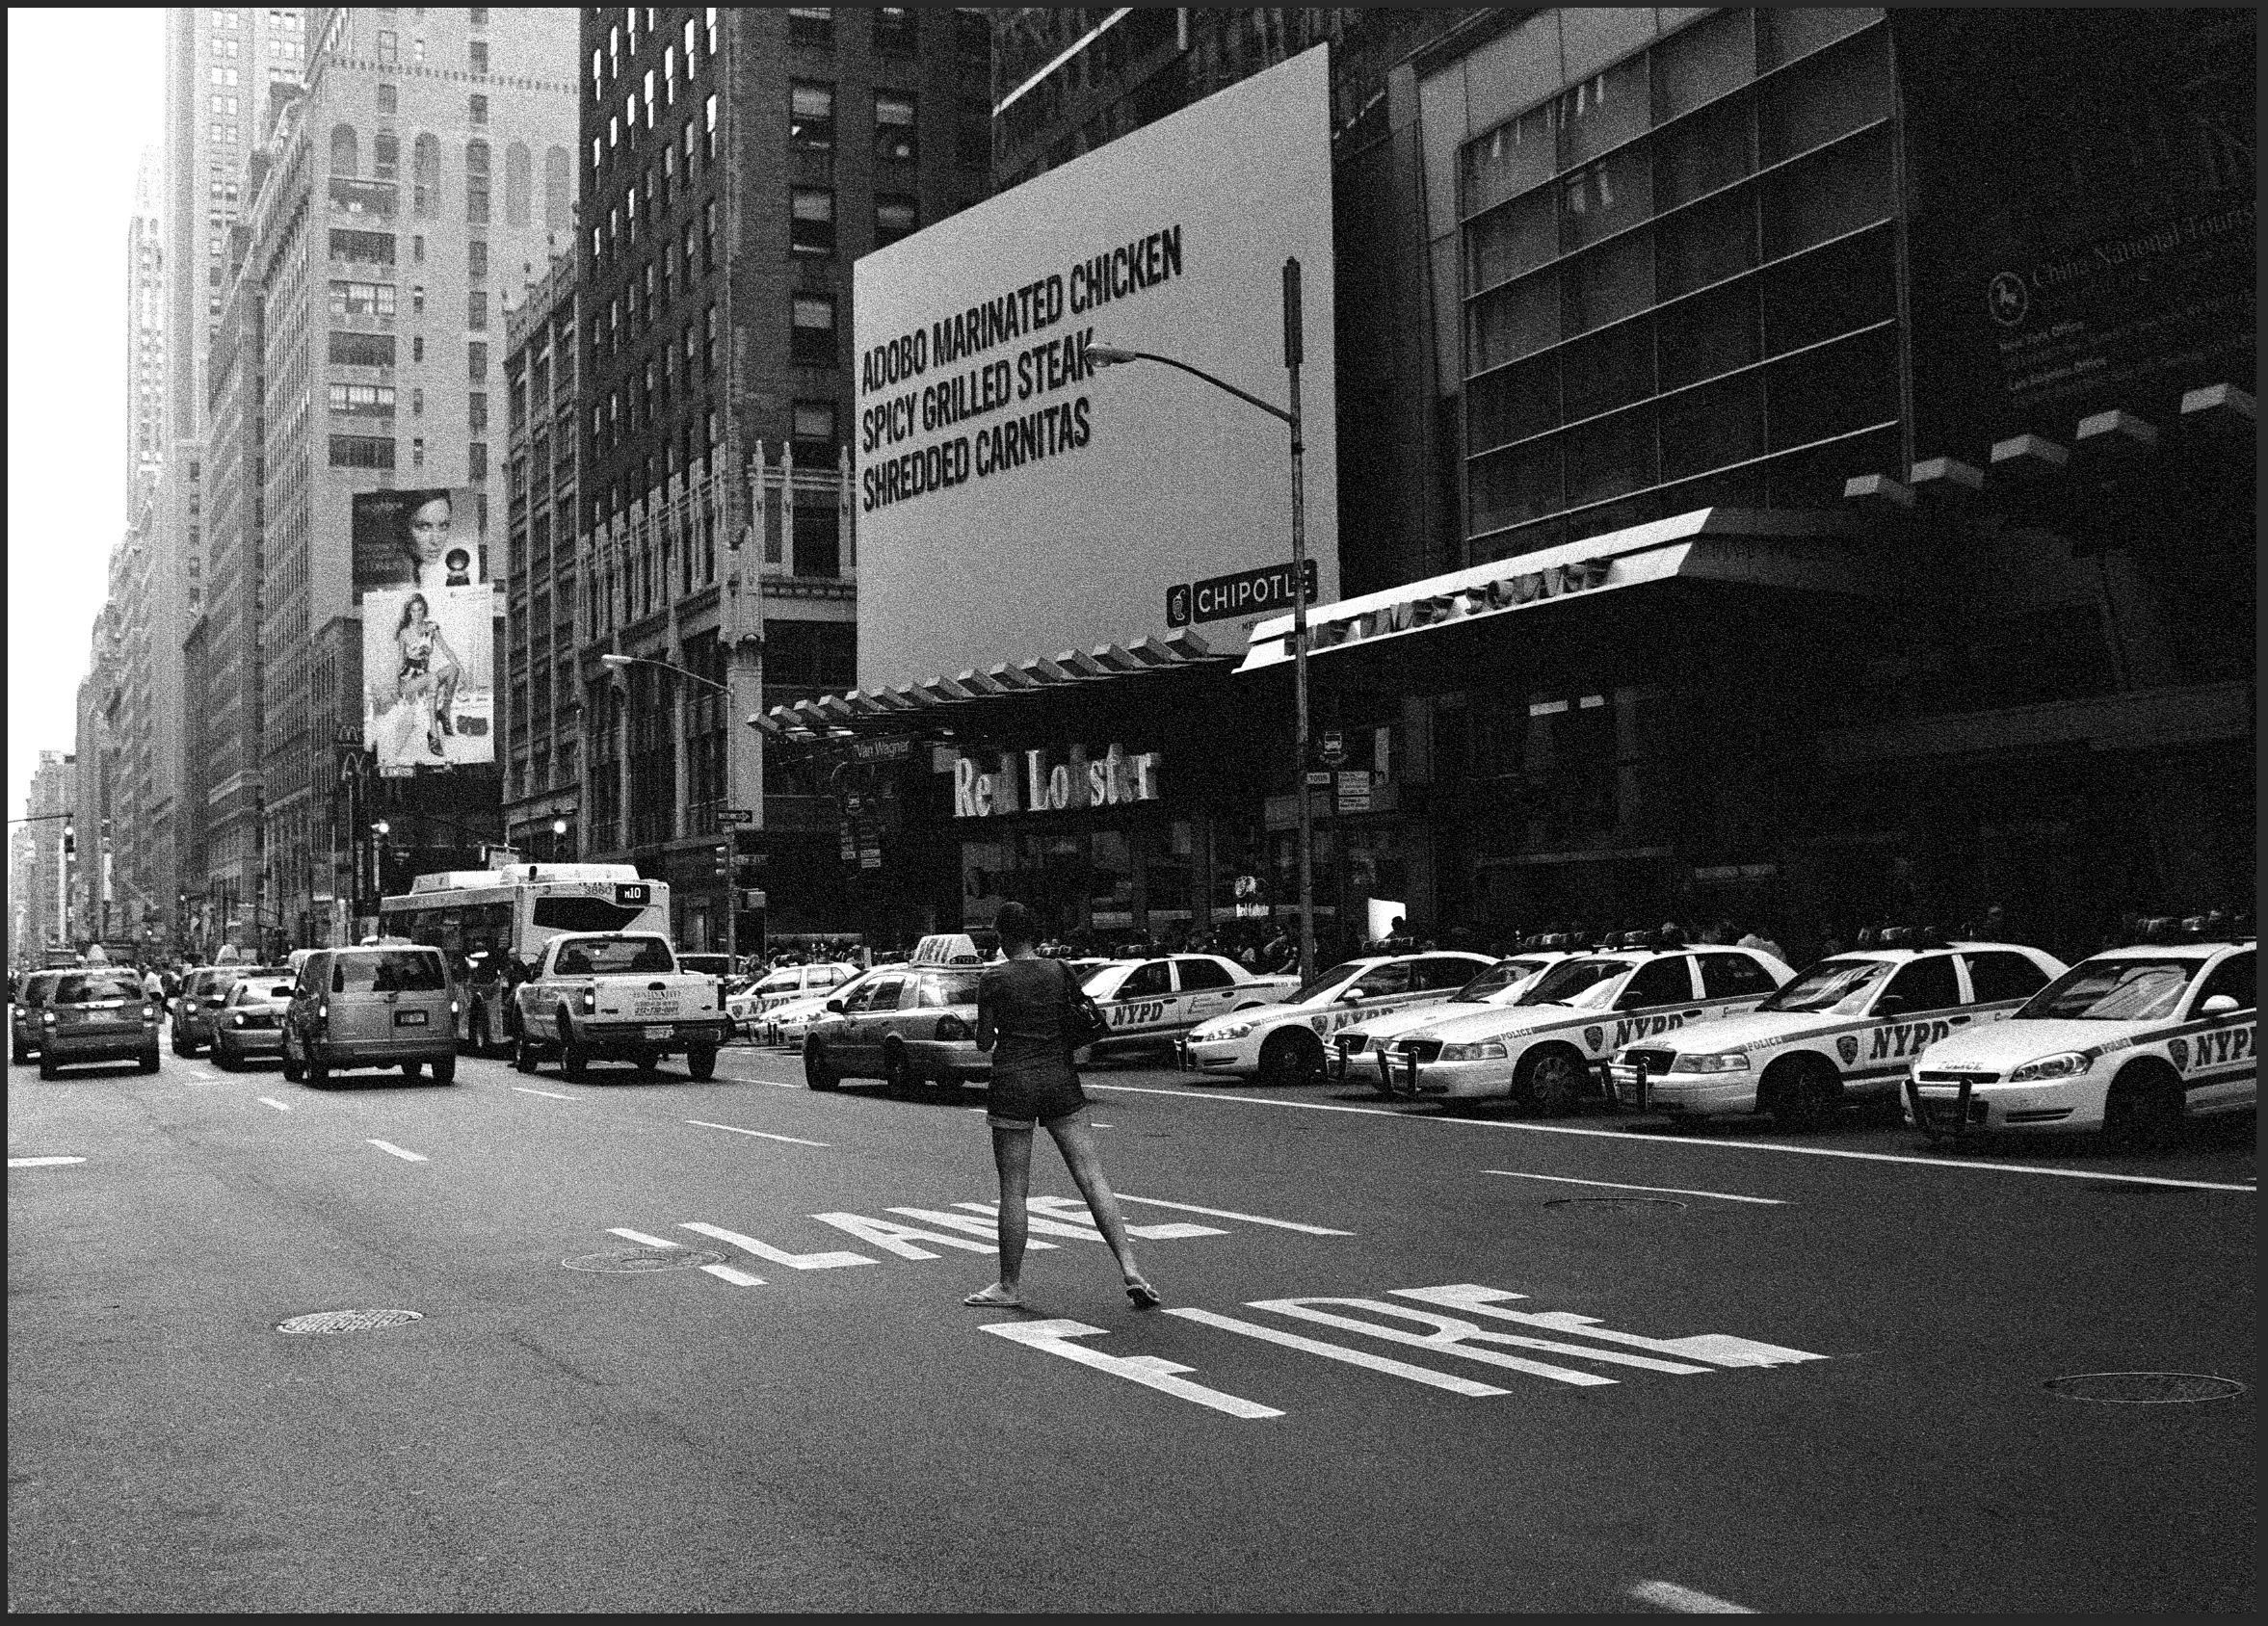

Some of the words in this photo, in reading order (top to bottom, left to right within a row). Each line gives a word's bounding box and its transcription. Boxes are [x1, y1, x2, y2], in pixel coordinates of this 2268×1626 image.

[862, 328, 928, 396] ADOBO
[933, 274, 1063, 367] MARINATED
[1069, 224, 1182, 315] CHICKEN
[862, 392, 917, 454] SPICY
[922, 359, 1011, 432] GRILLED
[1017, 327, 1094, 401] STEAK
[863, 436, 970, 512] SHREDDED
[975, 397, 1090, 478] CARNITAS
[1111, 1002, 1164, 1027] NYPD
[1500, 1027, 1532, 1042] POLICE
[1613, 1013, 1684, 1049] NYPD
[1869, 1021, 1949, 1060] NYPD
[1747, 1036, 1782, 1052] POLICE
[678, 1195, 1231, 1270] LANE
[977, 1282, 1831, 1419] FIRE
